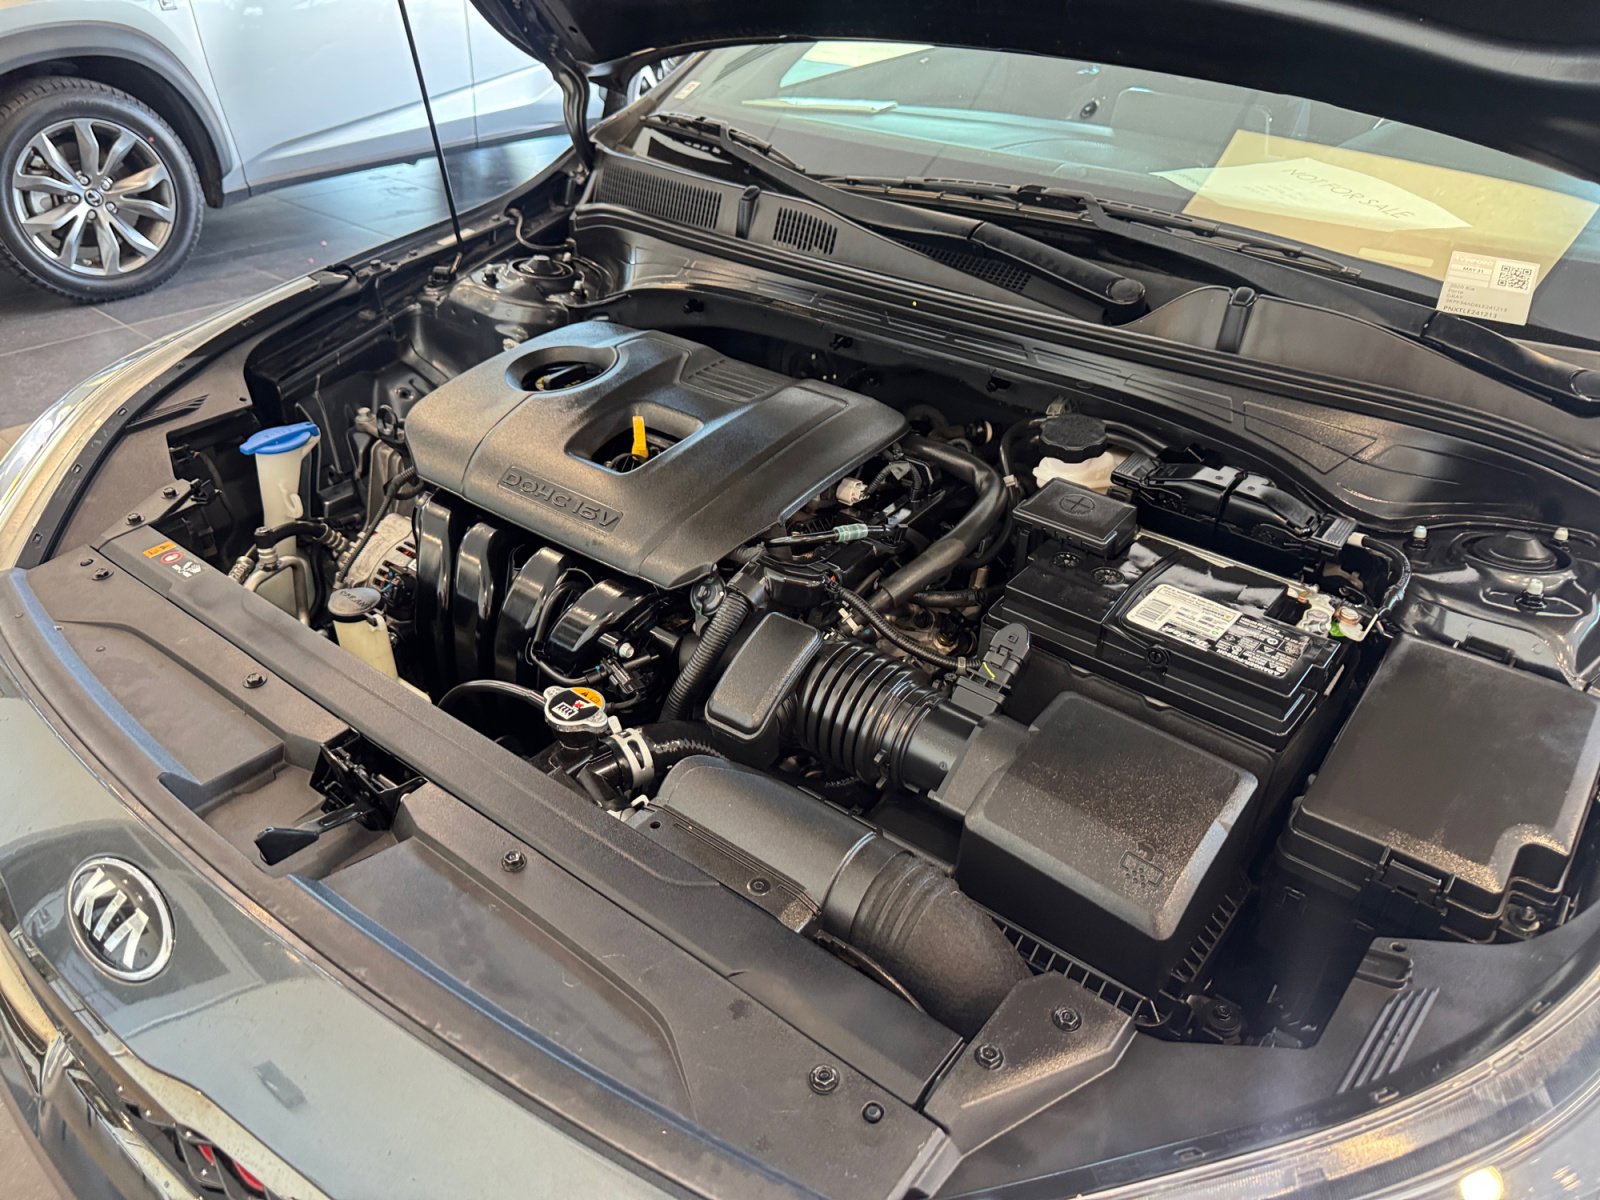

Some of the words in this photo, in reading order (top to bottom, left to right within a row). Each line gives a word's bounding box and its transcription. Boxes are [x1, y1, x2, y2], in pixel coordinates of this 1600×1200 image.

[1281, 168, 1329, 184] NOT
[1320, 183, 1365, 199] FOR
[1358, 199, 1416, 219] SALE
[502, 472, 572, 508] DOHC
[1160, 625, 1212, 649] Duralast
[73, 867, 149, 969] KIA
